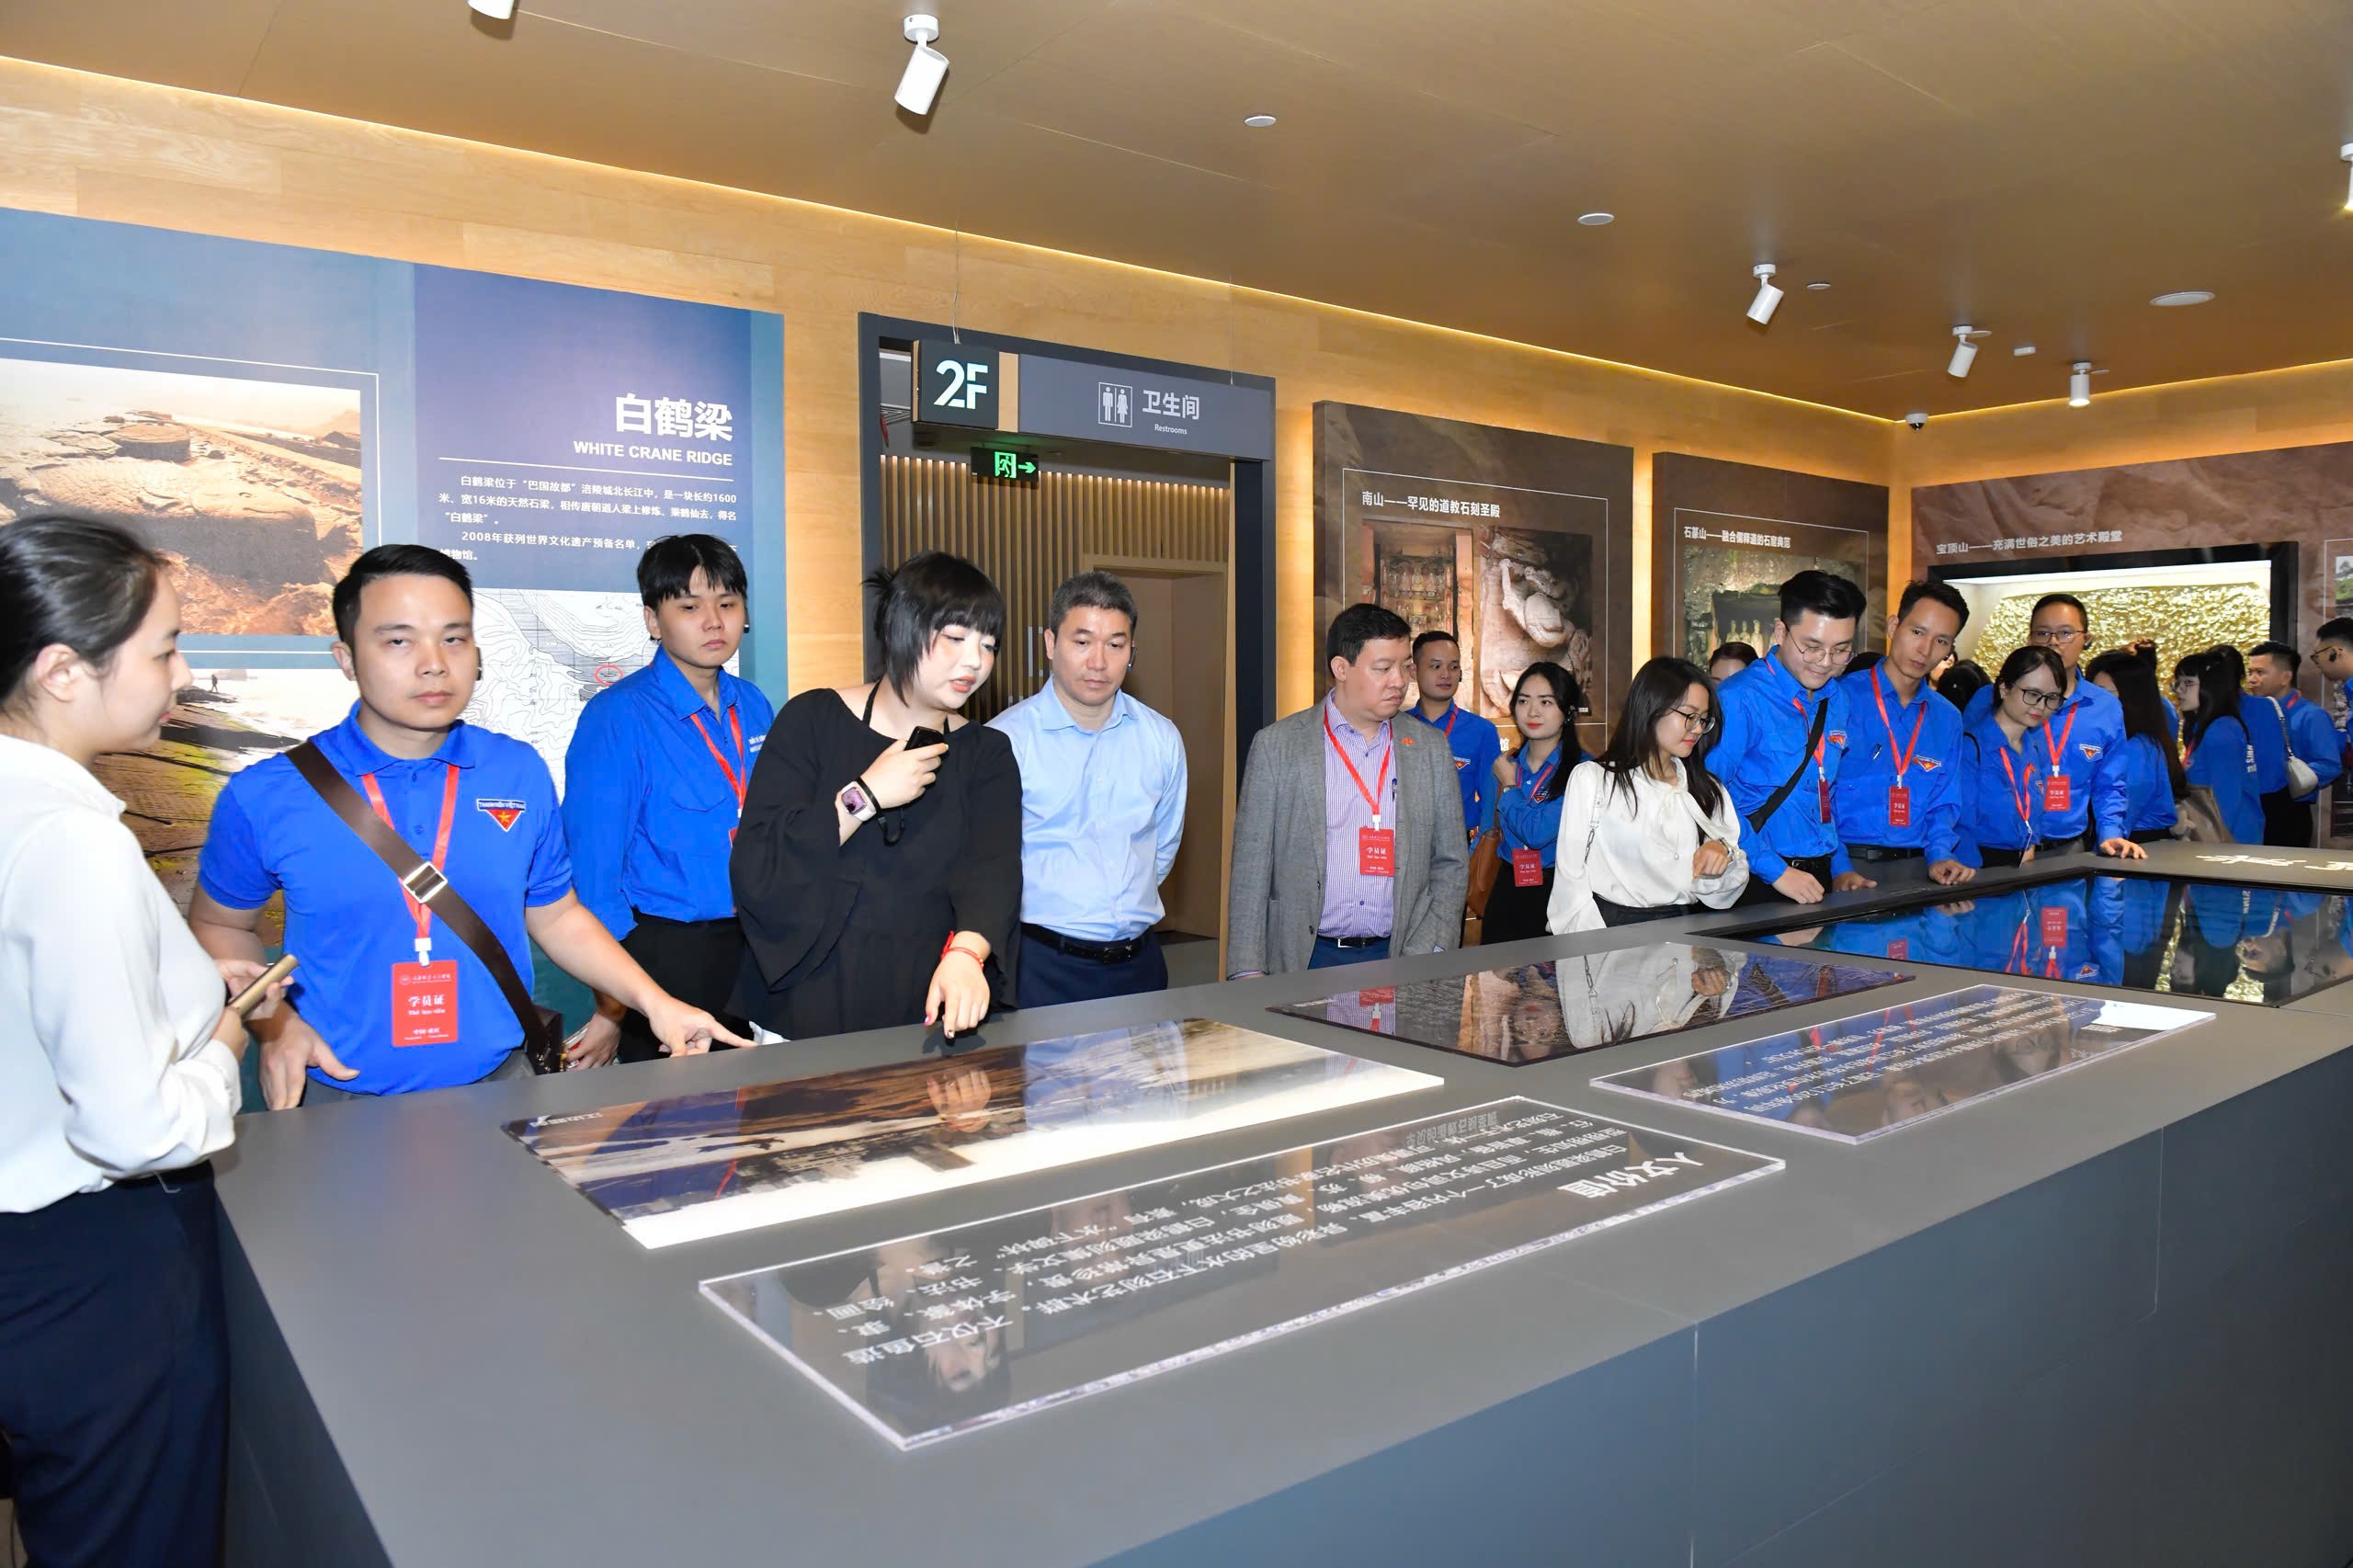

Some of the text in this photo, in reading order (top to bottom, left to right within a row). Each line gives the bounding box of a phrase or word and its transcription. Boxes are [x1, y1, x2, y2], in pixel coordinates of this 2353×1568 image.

[933, 359, 988, 410] 2F
[616, 392, 733, 442] 白鹤梁
[1142, 389, 1199, 420] 卫生间
[1154, 424, 1188, 435] Restrooms
[574, 440, 733, 466] WHITE CRANE RIDGE
[407, 994, 446, 1007] 学员证
[1557, 1153, 1706, 1199] 人文价值
